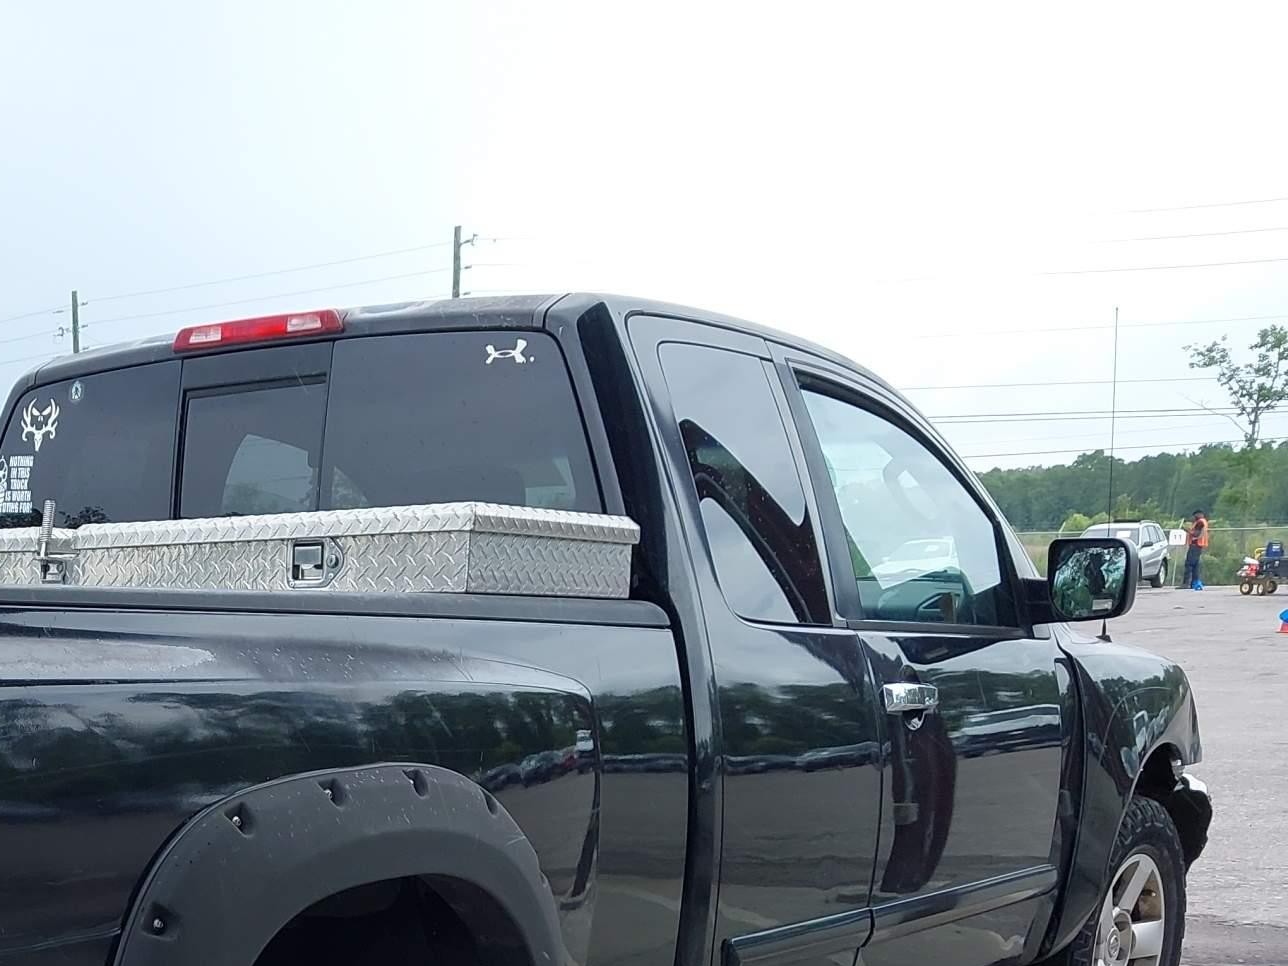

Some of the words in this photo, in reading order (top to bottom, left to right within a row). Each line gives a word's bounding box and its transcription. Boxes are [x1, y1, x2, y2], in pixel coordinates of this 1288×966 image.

[9, 455, 34, 467] NOTHING
[18, 467, 31, 479] THIS
[10, 479, 29, 490] TRUCK
[12, 490, 32, 502] WORTH
